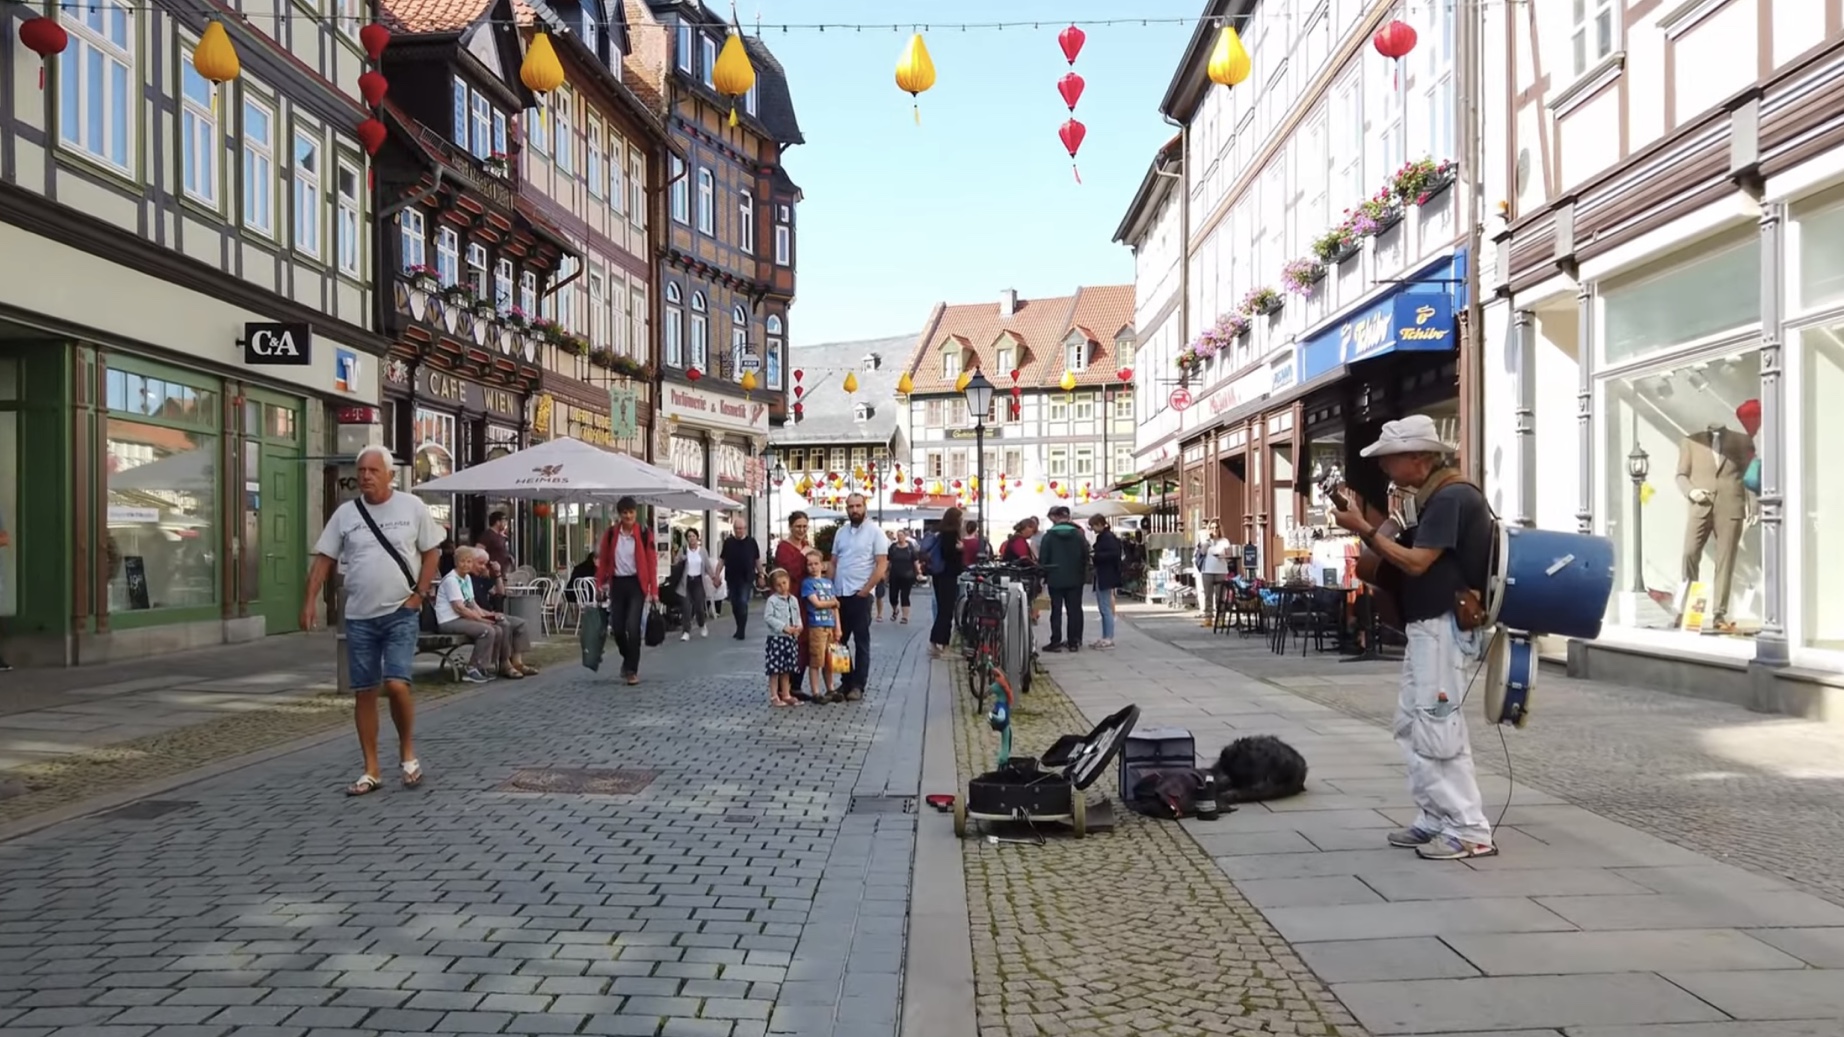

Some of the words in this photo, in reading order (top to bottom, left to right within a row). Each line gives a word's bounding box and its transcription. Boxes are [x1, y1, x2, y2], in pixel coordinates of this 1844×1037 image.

[251, 330, 299, 356] C&A
[1354, 311, 1392, 354] Tchibo
[1399, 327, 1450, 340] Tchibo
[429, 372, 467, 402] CAFE
[483, 388, 514, 415] WIEN
[711, 403, 716, 413] &
